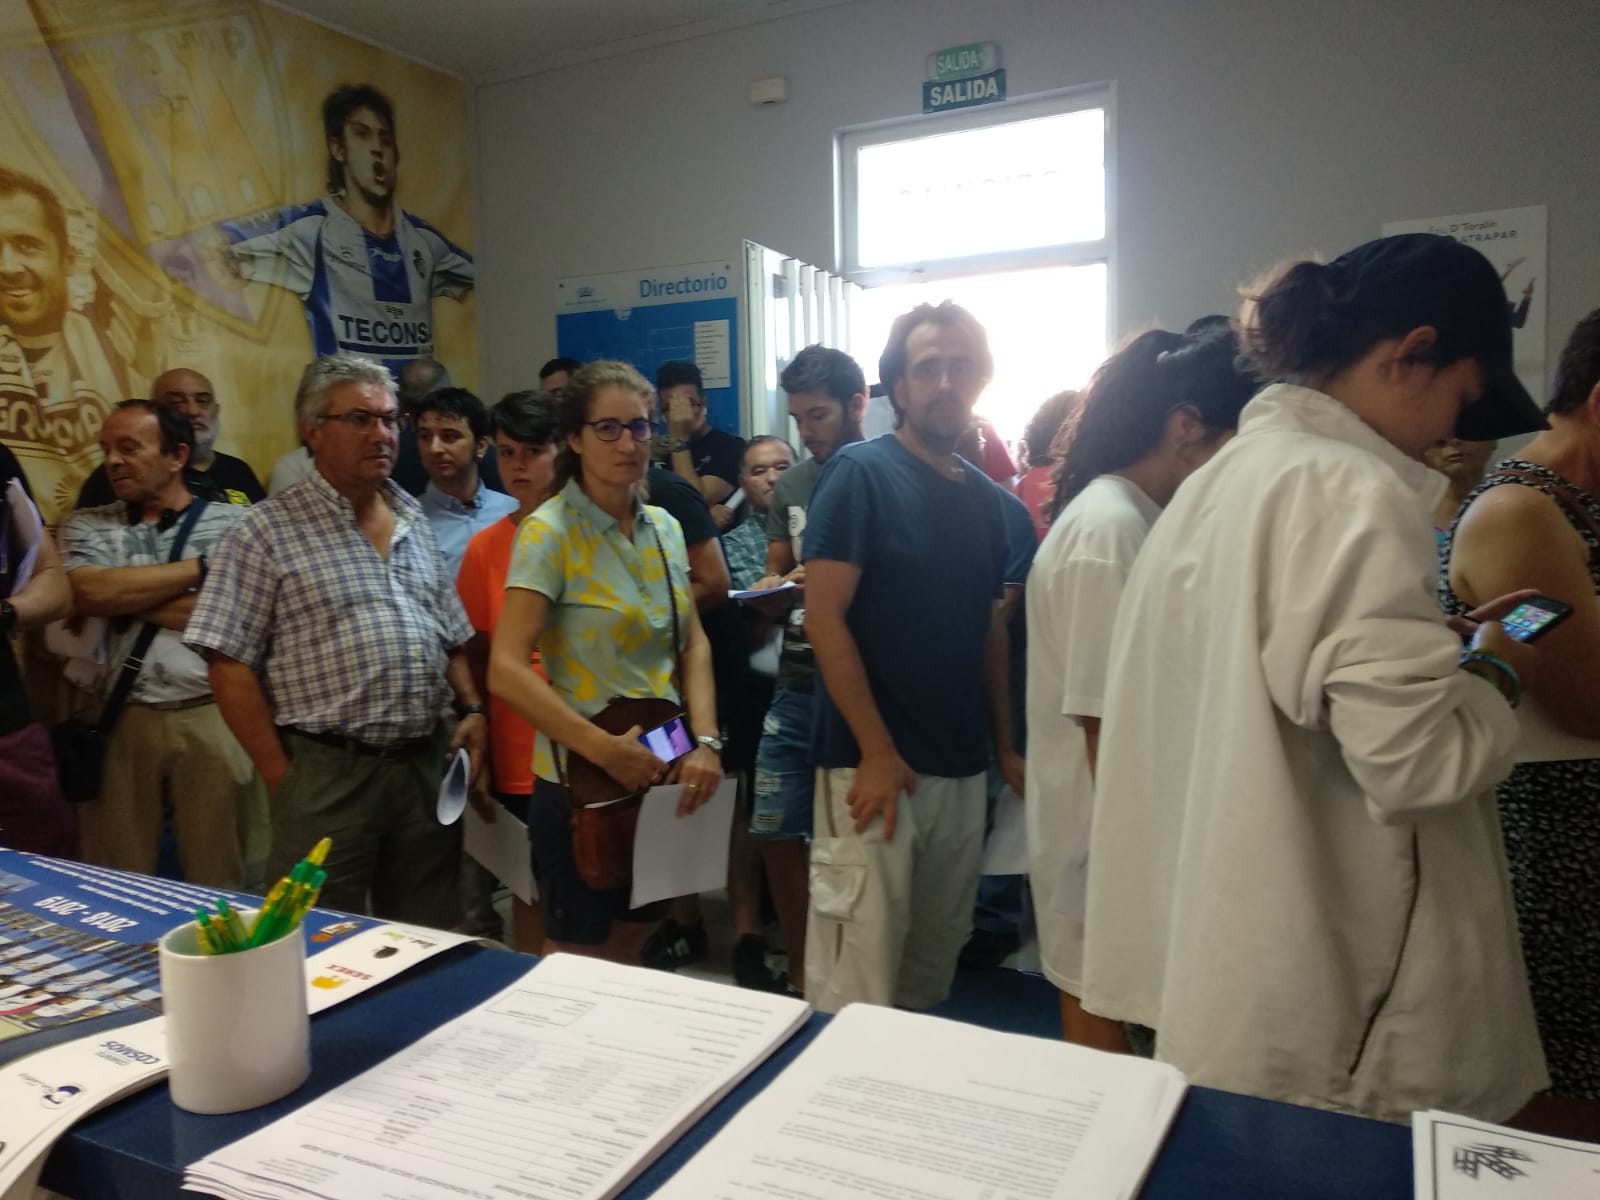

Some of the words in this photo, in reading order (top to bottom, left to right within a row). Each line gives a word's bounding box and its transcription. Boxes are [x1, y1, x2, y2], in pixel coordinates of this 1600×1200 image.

[937, 50, 979, 74] SALIDA
[930, 77, 999, 106] SALIDA
[639, 273, 727, 298] Directorio
[33, 895, 91, 916] 2019
[79, 911, 140, 933] 2018
[100, 1040, 160, 1065] COSMOS
